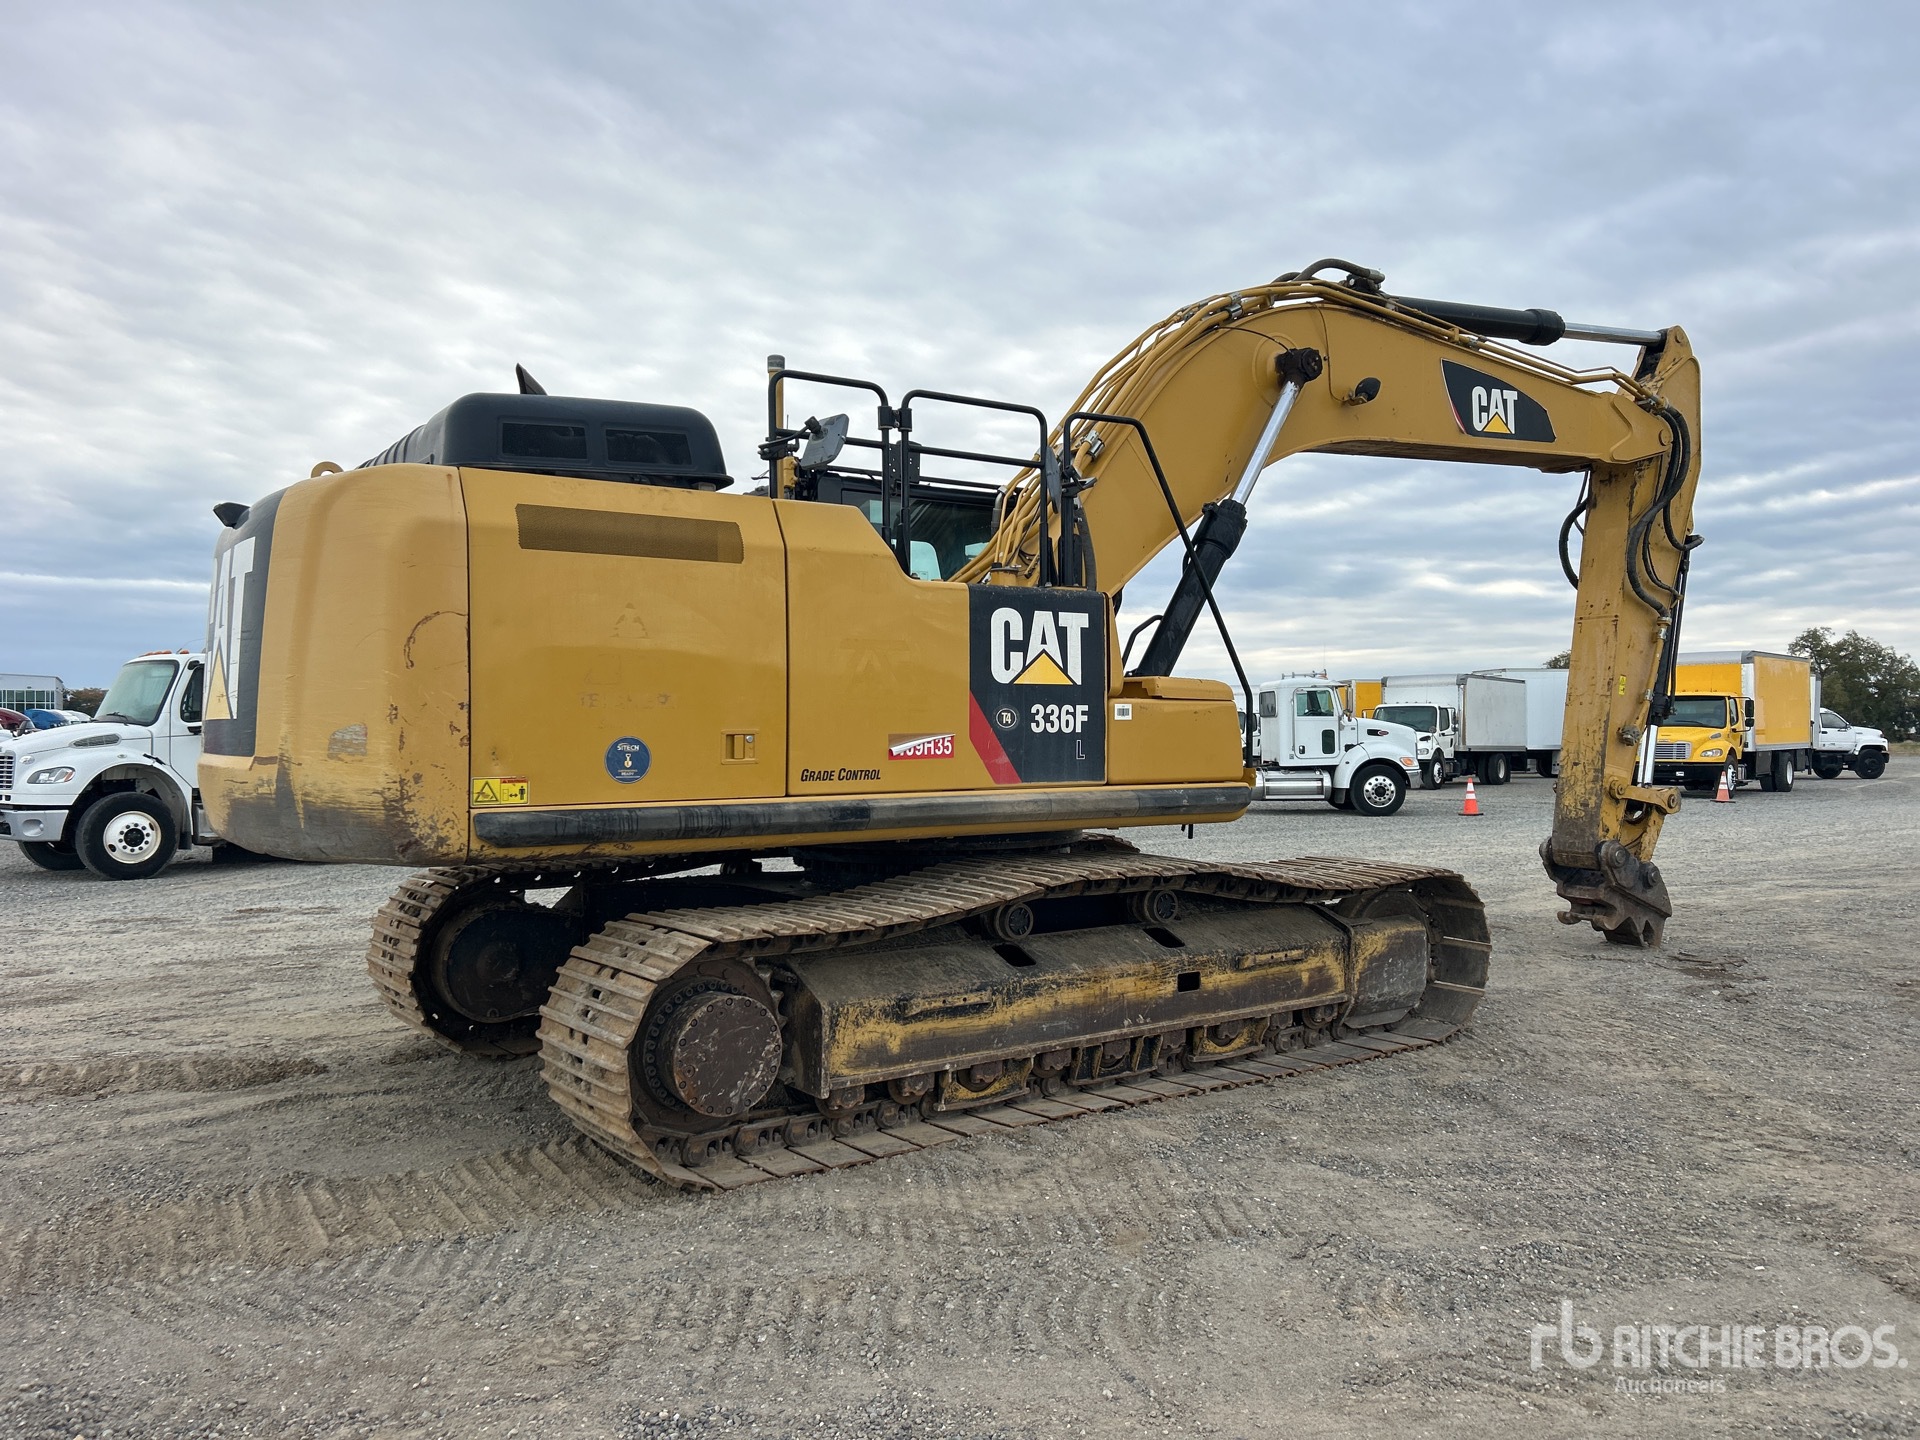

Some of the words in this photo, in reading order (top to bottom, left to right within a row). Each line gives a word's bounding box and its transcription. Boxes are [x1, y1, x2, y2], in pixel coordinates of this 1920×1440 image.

[1471, 386, 1518, 435] CAT
[990, 607, 1089, 685] CAT
[1030, 703, 1089, 733] 336F
[1075, 739, 1086, 760] L
[800, 768, 835, 782] GRADE
[837, 767, 881, 781] CONTROL
